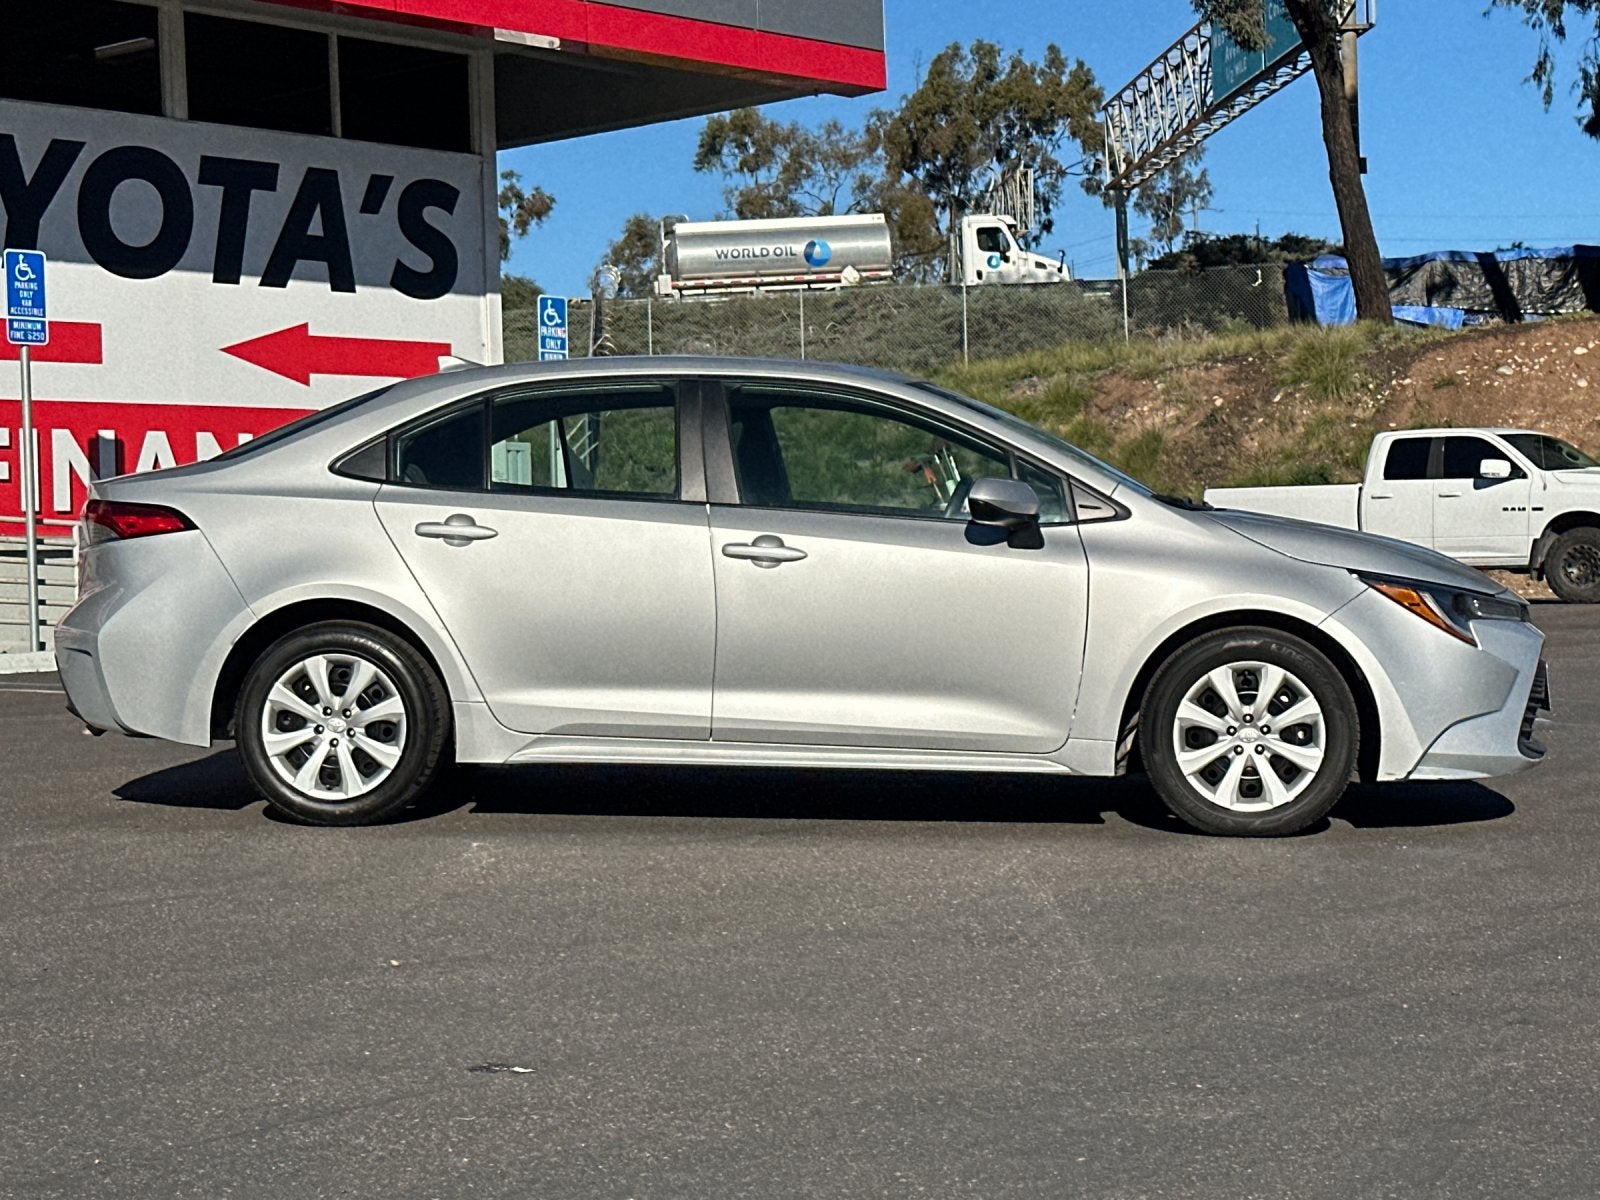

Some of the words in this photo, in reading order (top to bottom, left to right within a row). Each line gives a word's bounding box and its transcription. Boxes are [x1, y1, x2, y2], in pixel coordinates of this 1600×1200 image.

[715, 247, 769, 260] WORLD
[773, 246, 797, 258] OIL
[14, 281, 38, 290] PARKING
[10, 307, 43, 316] ACCESSIBLE
[13, 321, 42, 330] MINIMUM
[10, 331, 25, 340] FINE
[27, 331, 45, 341] $250
[540, 326, 566, 338] PARKING
[545, 338, 561, 349] ONLY
